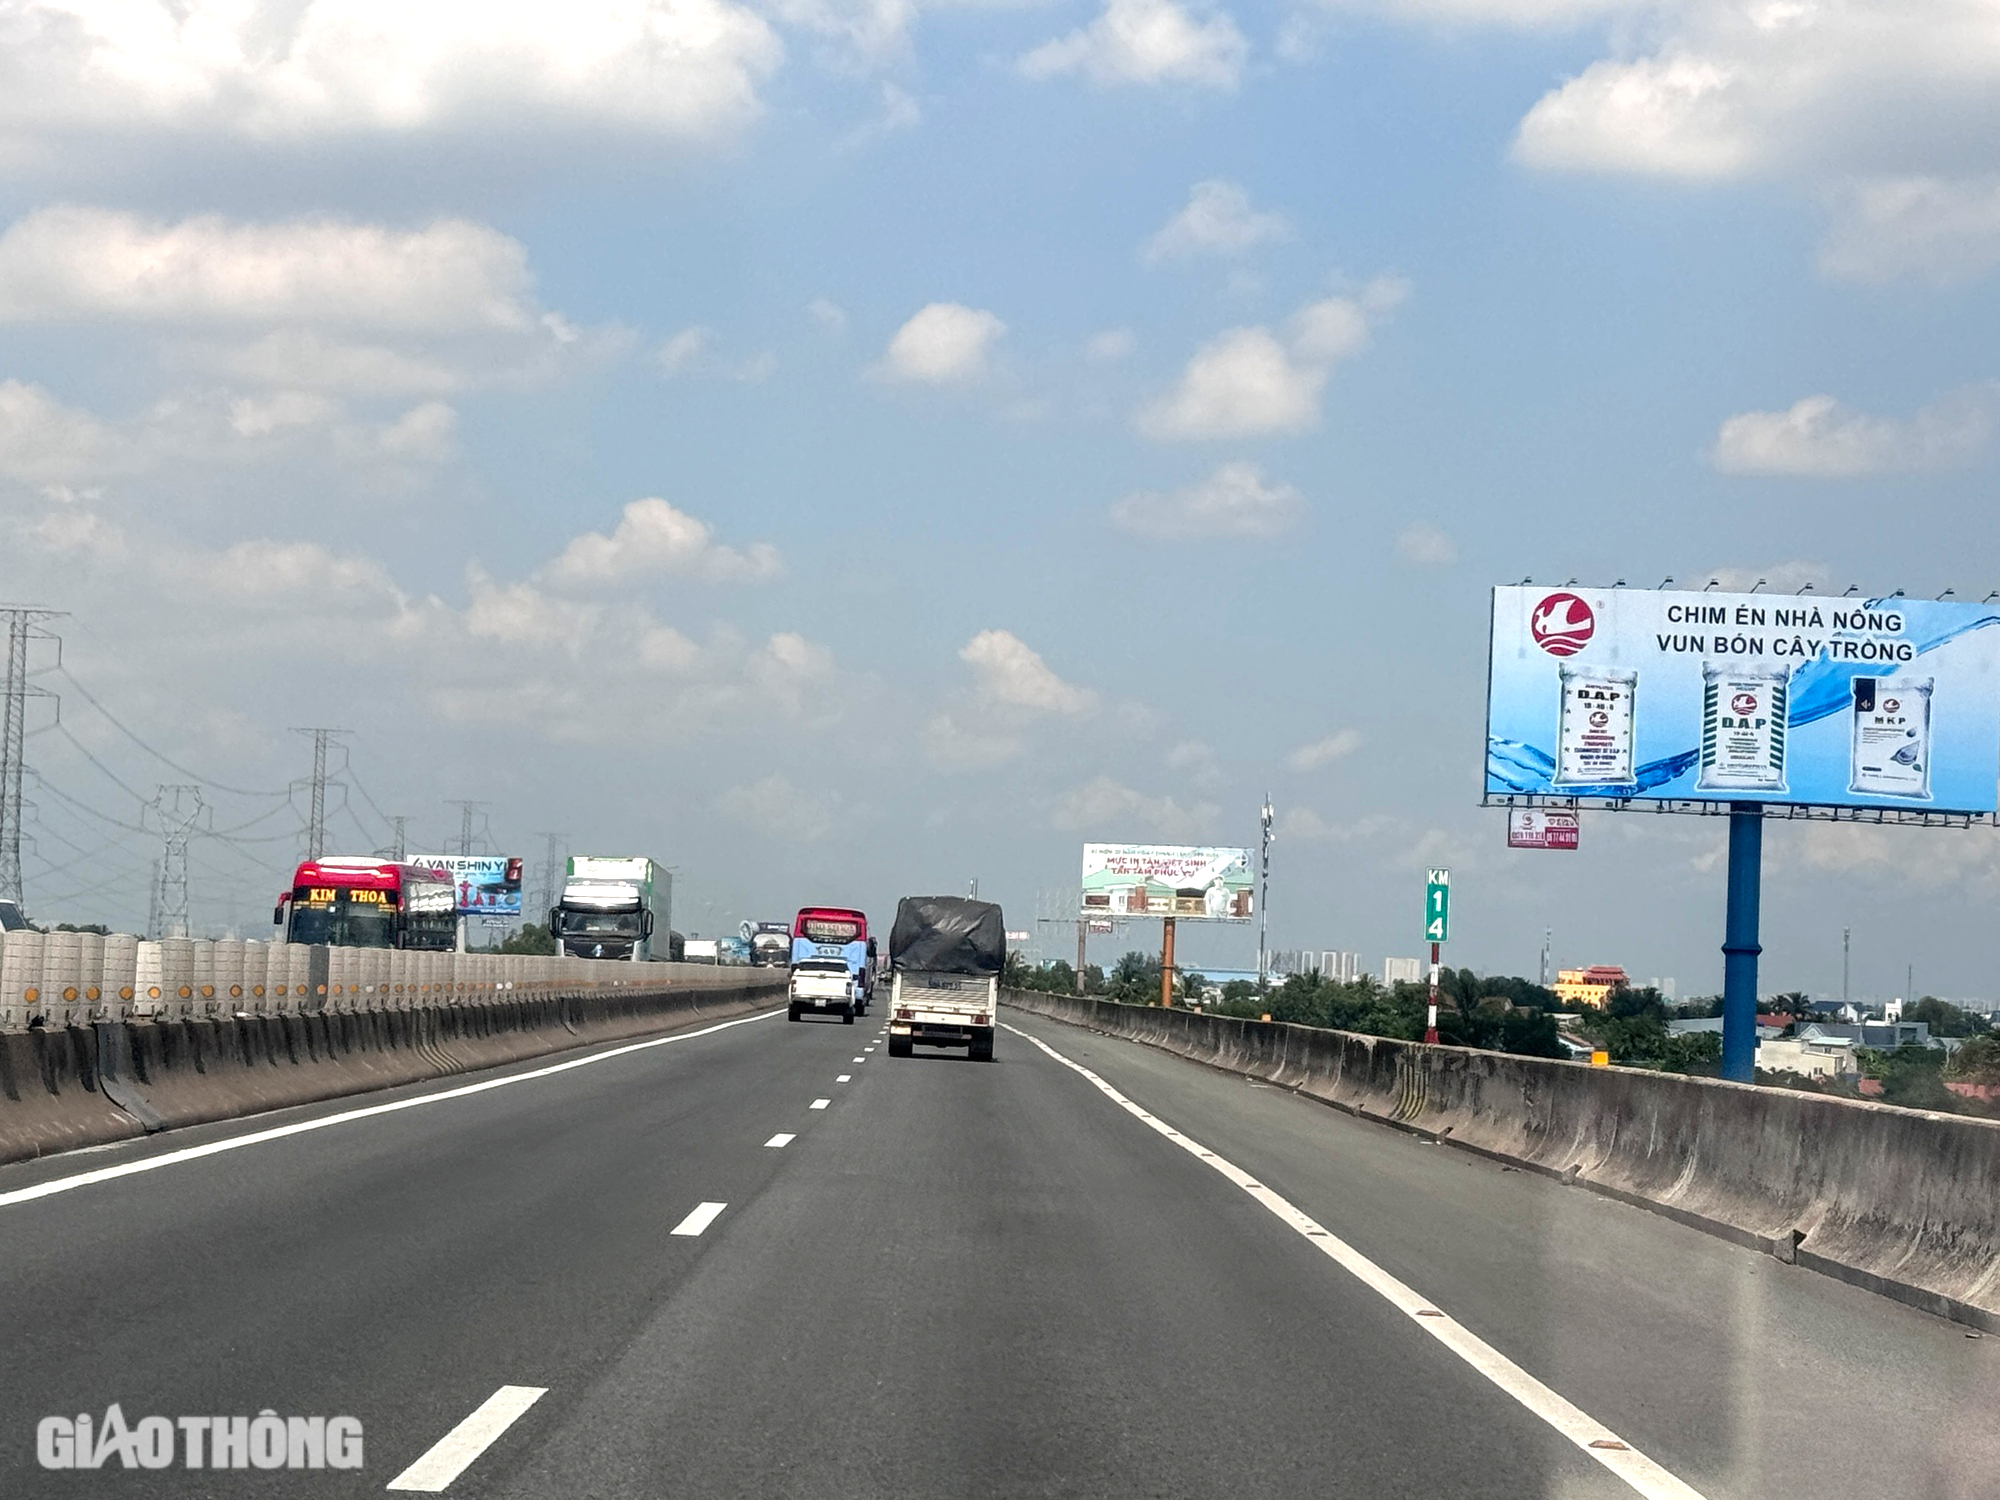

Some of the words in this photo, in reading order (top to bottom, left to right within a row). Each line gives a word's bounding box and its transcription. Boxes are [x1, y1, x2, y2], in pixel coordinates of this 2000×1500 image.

[1667, 605, 1726, 624] CHIM
[1735, 604, 1766, 626] ÉN
[1775, 606, 1825, 629] NHÀ
[1833, 609, 1901, 632] NÔNG
[1656, 634, 1705, 653] VUN
[1713, 632, 1764, 655] BÓN
[1773, 635, 1822, 658] CÂY
[426, 859, 455, 870] VAN
[1428, 869, 1449, 886] KM
[310, 888, 337, 902] KIM
[349, 889, 387, 904] THOA
